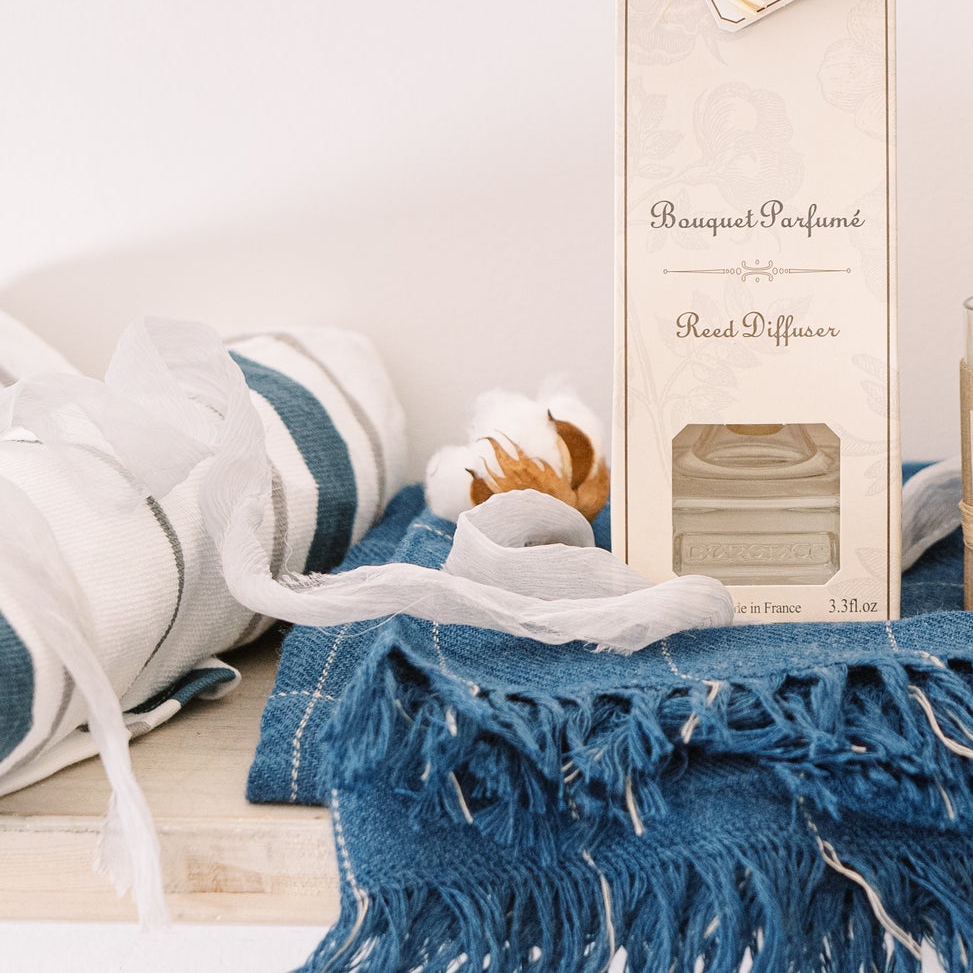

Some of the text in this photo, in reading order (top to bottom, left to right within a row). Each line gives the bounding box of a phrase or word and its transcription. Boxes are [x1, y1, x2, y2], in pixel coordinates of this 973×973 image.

[650, 199, 866, 238] Bouquet Parfumé
[676, 311, 841, 347] Reed Diffuser
[750, 602, 761, 614] in
[764, 602, 802, 614] France
